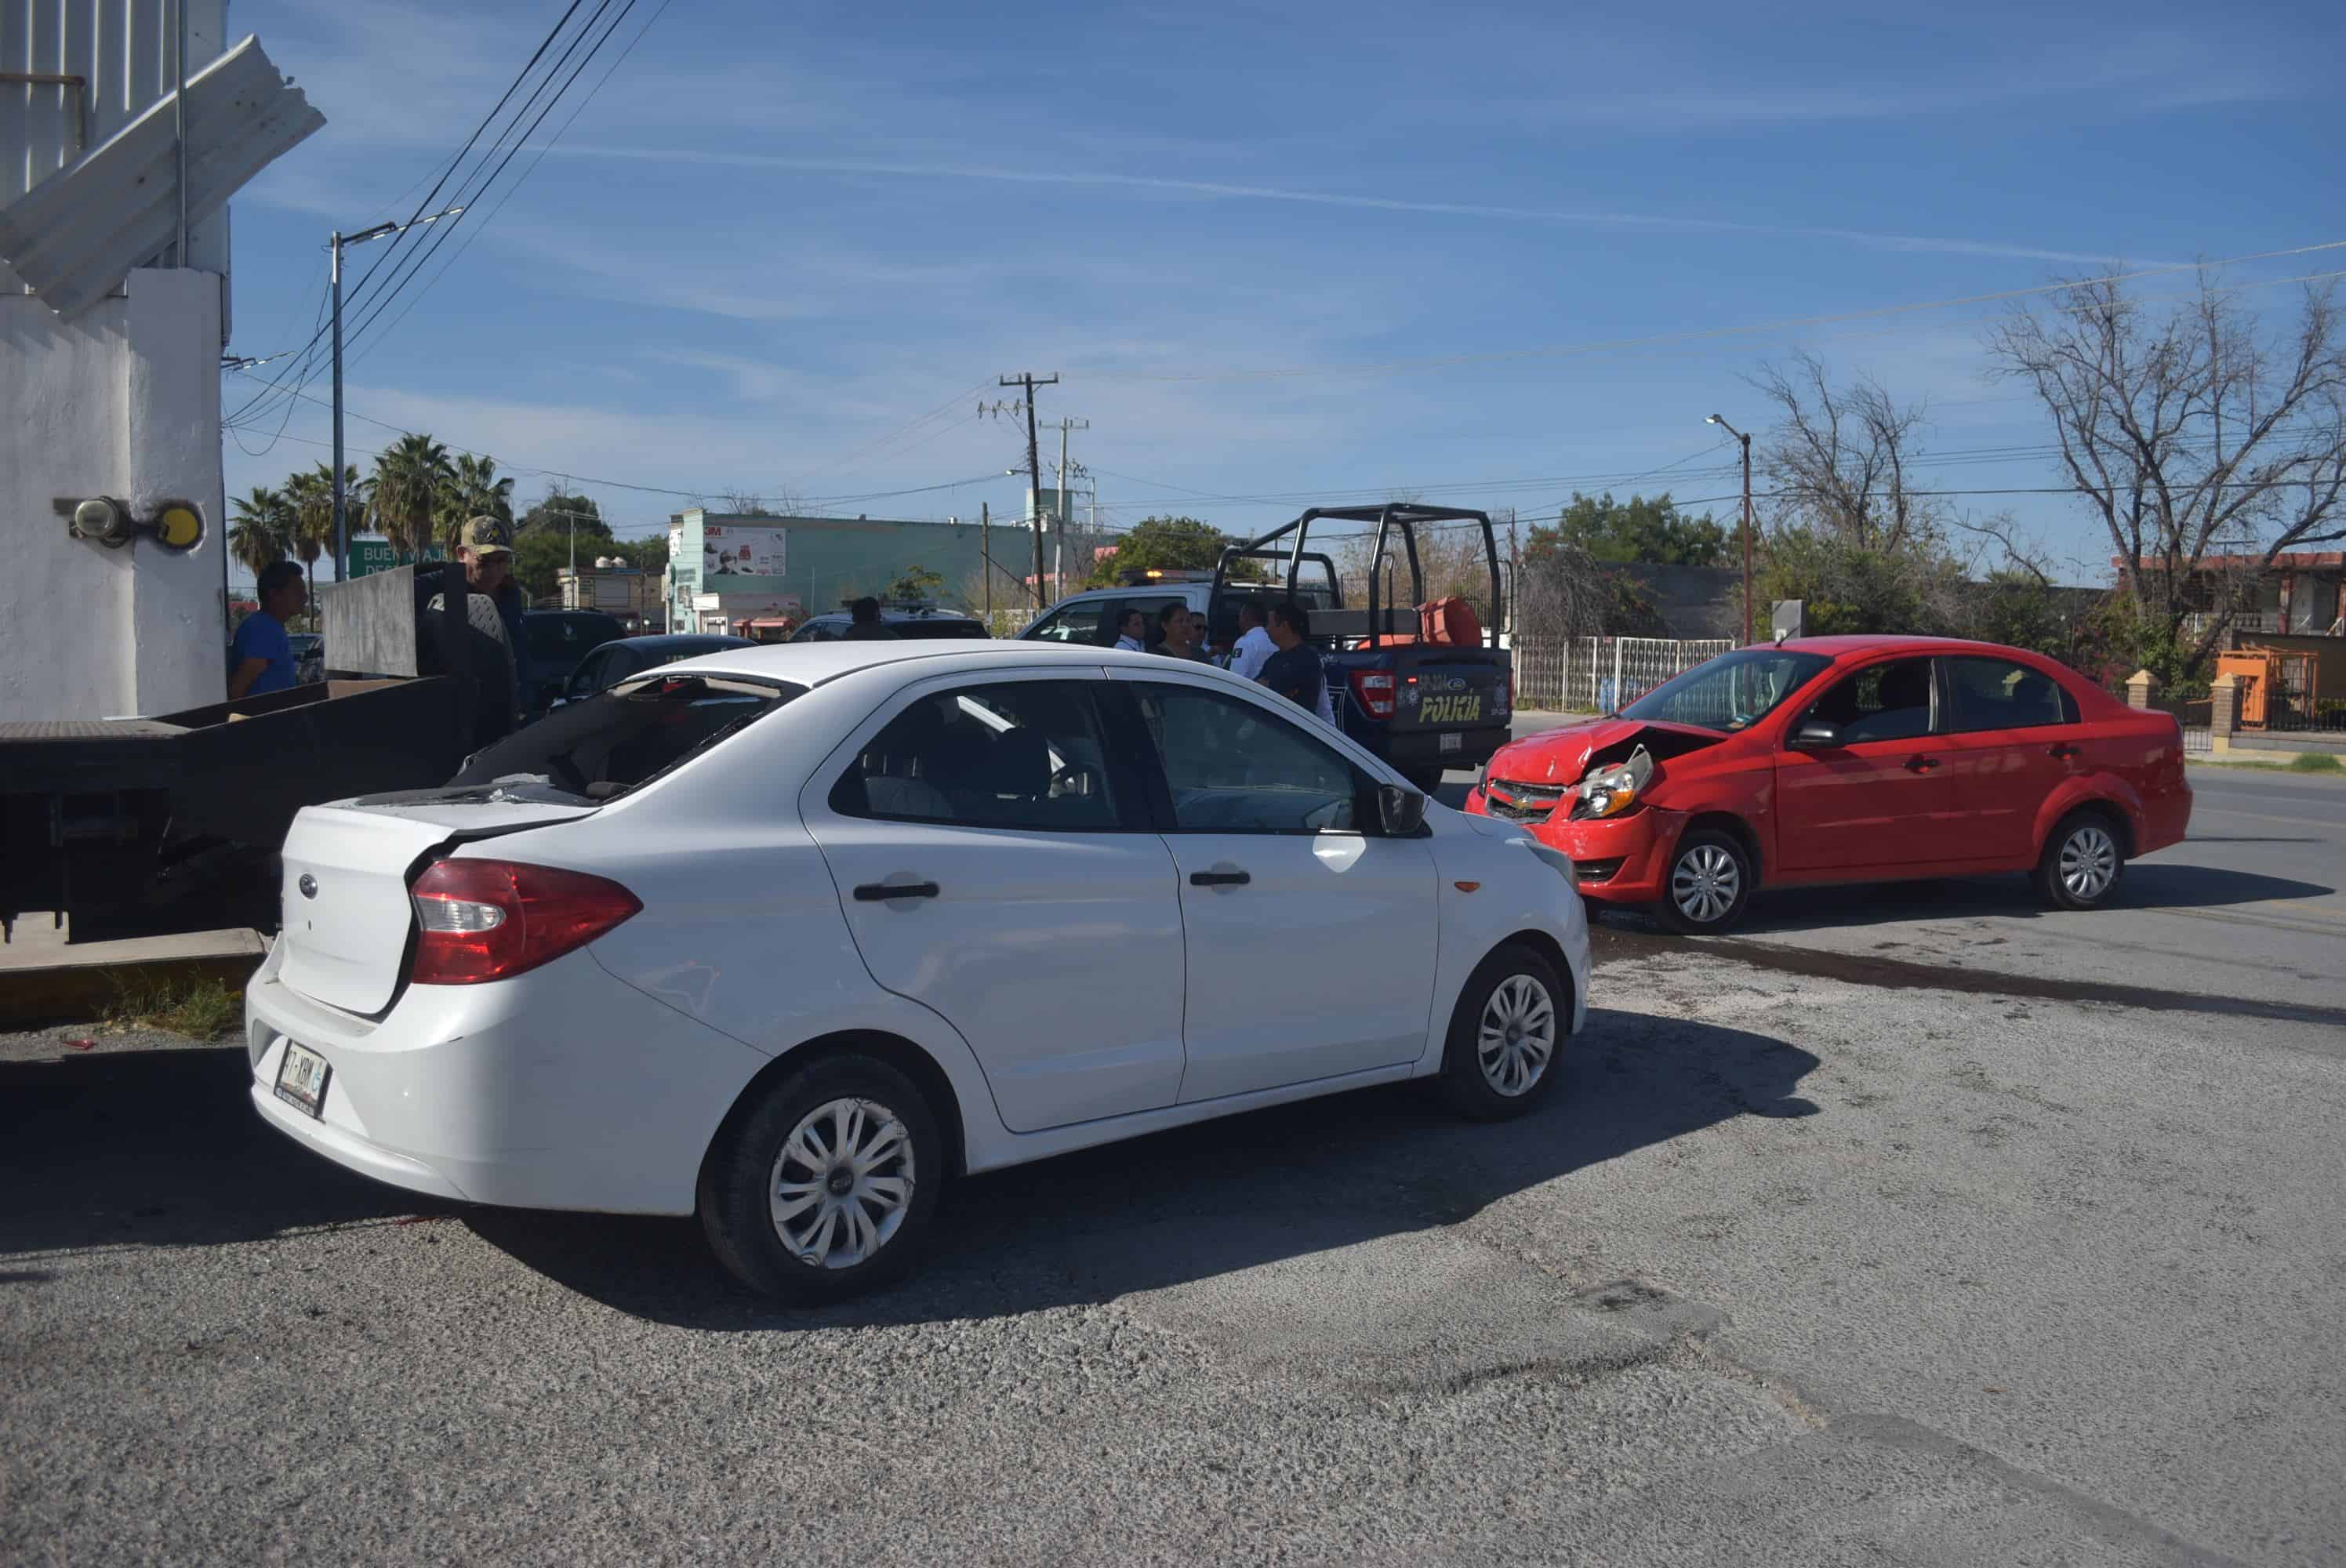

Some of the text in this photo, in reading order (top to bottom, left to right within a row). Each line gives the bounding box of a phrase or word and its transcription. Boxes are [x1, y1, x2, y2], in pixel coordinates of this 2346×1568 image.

[704, 526, 721, 536] 3M
[364, 547, 400, 561] BUEN
[1418, 688, 1481, 724] POLICÍA
